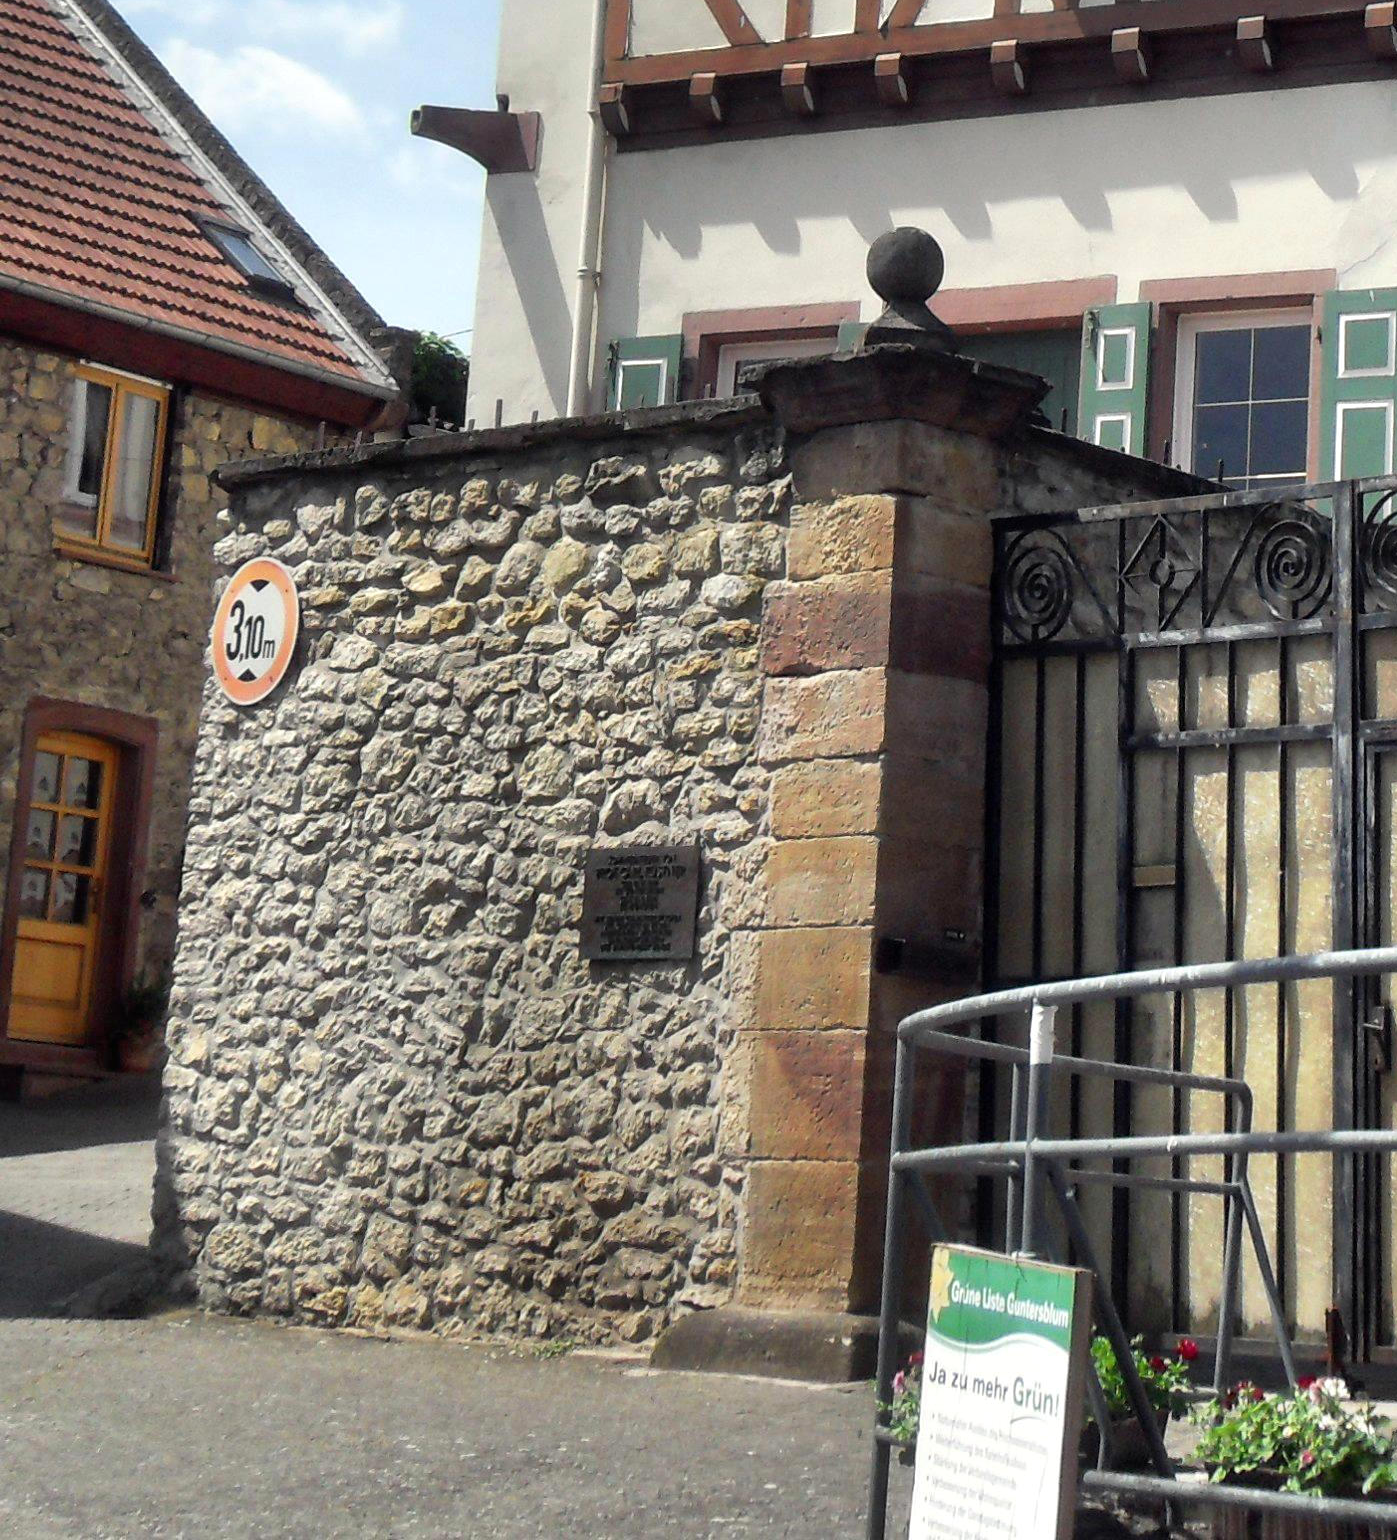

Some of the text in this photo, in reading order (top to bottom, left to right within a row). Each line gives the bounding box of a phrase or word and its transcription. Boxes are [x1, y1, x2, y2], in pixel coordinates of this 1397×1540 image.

[982, 1287, 1005, 1312] Liste
[1006, 1292, 1069, 1328] Guntersblum
[929, 1361, 1060, 1417] Ja zu mehr Grün!
